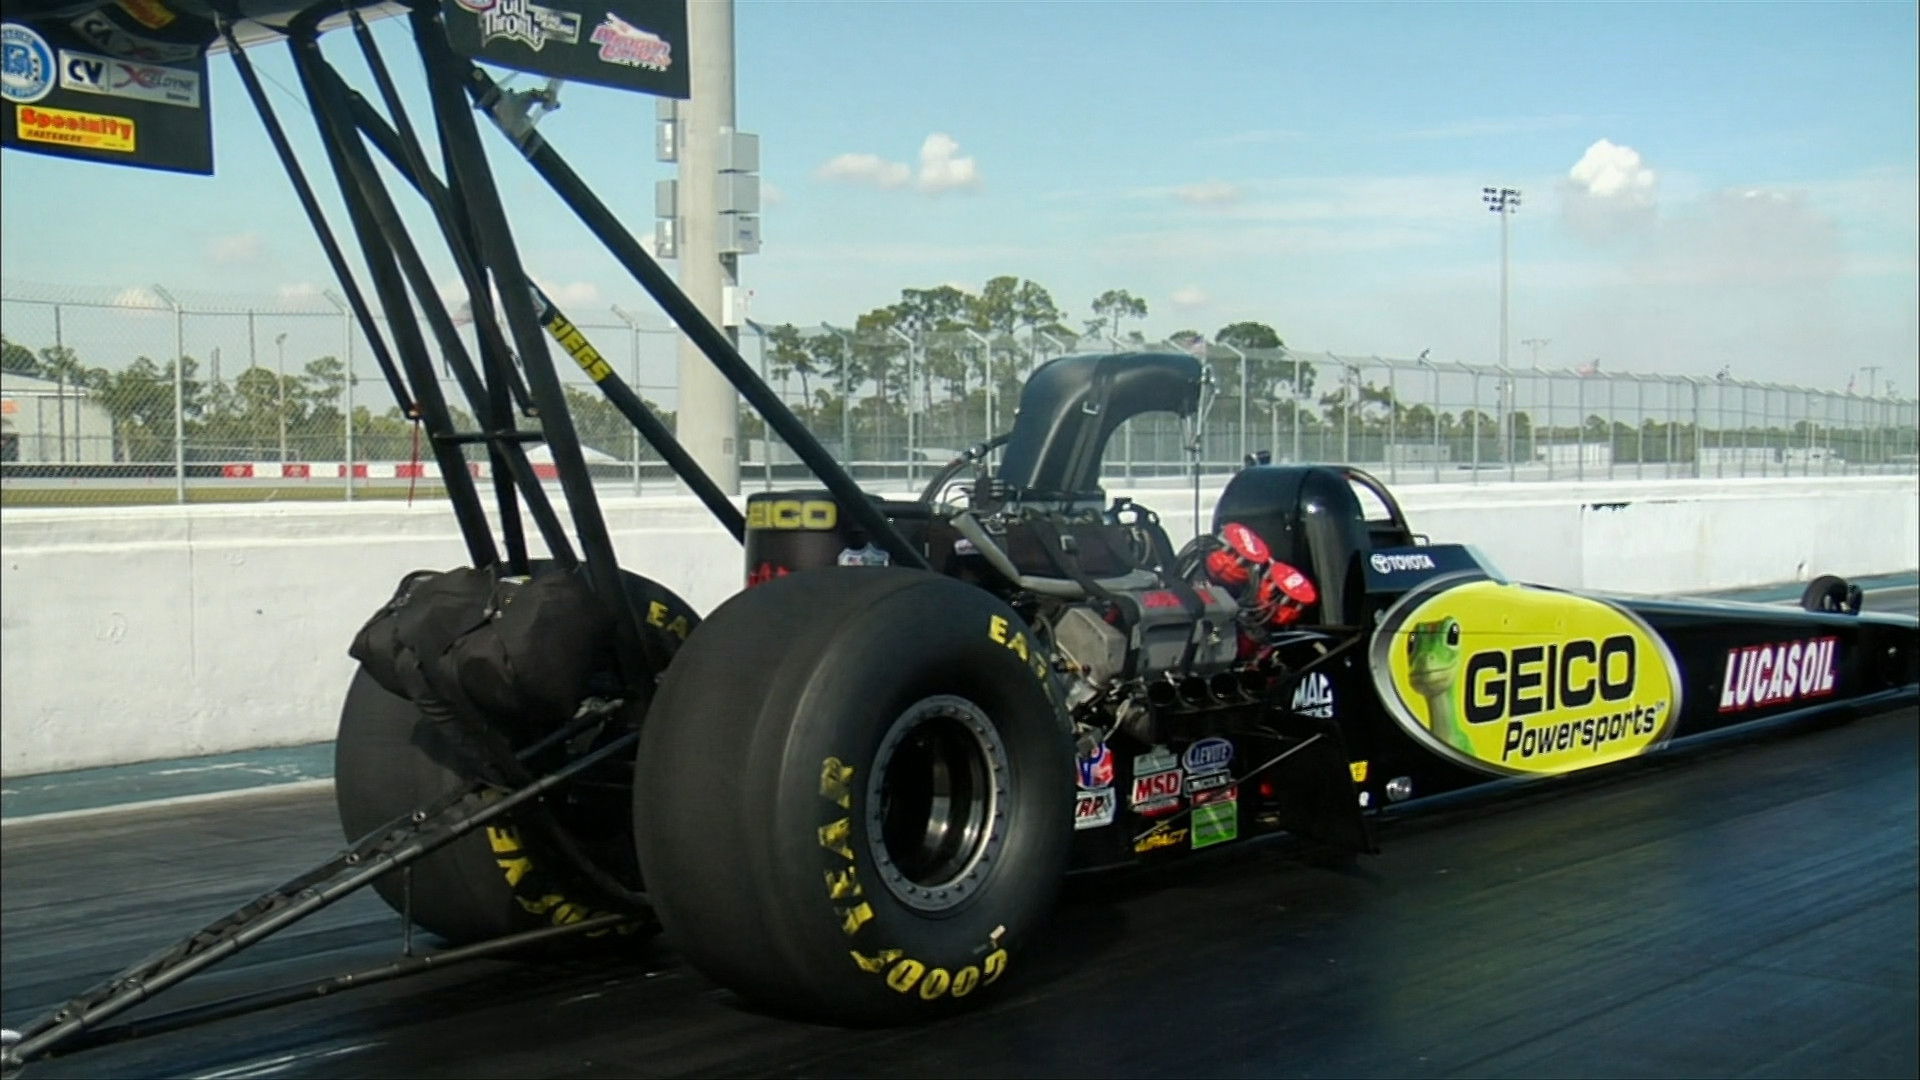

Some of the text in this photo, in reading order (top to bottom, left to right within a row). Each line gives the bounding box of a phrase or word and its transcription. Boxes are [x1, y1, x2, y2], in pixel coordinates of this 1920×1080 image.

[67, 59, 105, 84] CV
[20, 108, 132, 140] Specialty
[1387, 554, 1436, 571] TOYOTA
[1465, 635, 1636, 724] GEICO
[1503, 703, 1656, 762] Powersports
[1137, 772, 1180, 803] MSD
